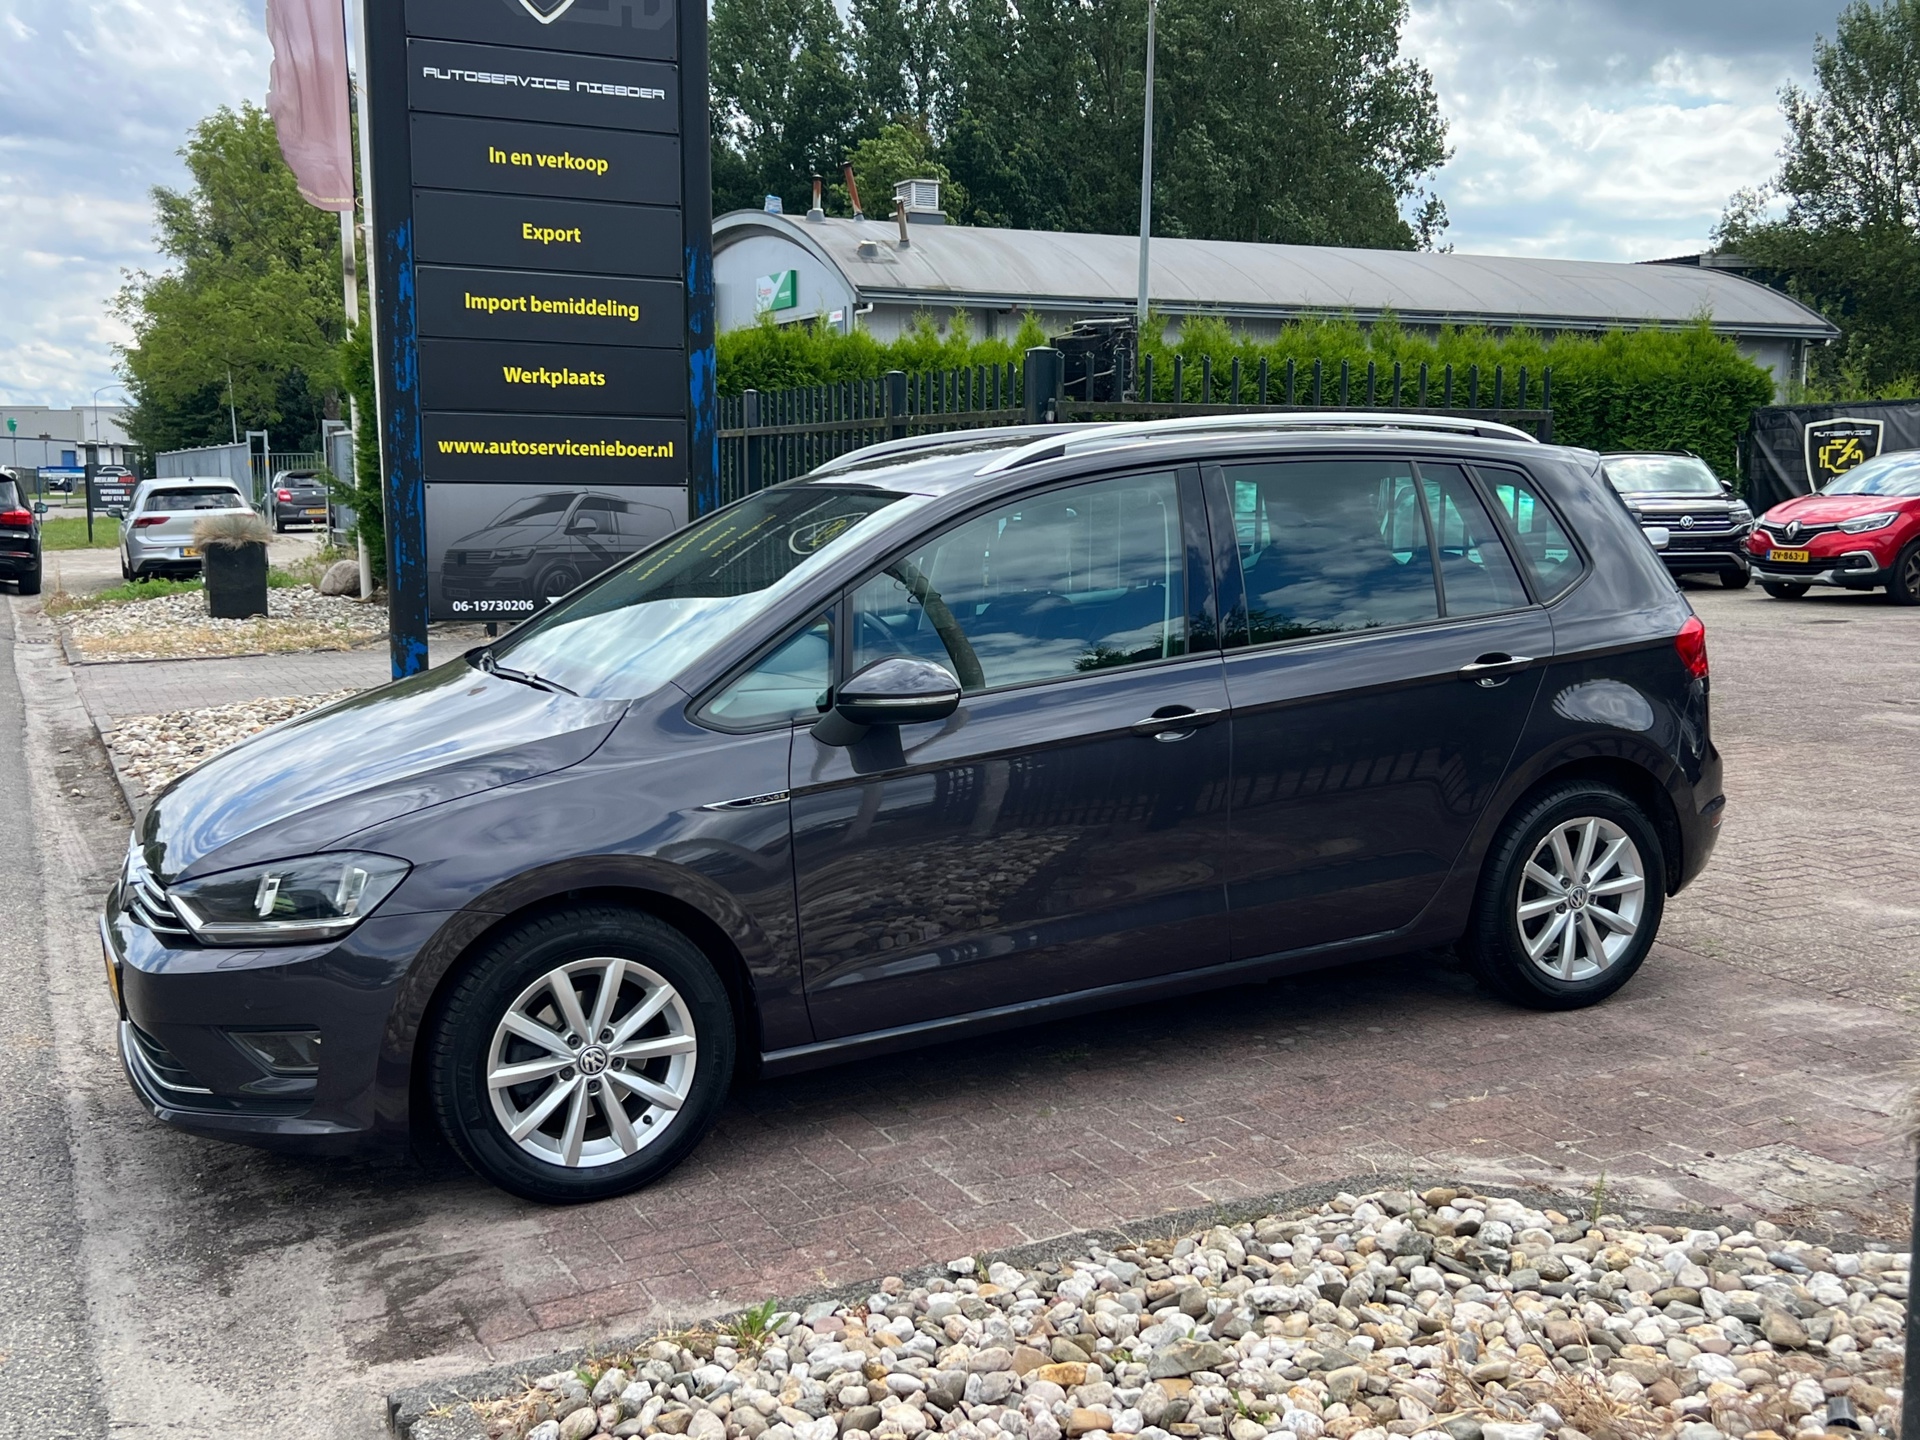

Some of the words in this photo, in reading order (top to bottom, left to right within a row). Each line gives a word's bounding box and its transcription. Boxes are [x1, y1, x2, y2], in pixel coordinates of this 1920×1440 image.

[423, 66, 571, 91] AUTOSERVICE
[576, 81, 665, 100] NIEBOER
[489, 146, 507, 164] In
[510, 152, 533, 166] en
[536, 152, 609, 175] verkoop
[523, 223, 581, 244] Export
[465, 293, 527, 314] Import
[530, 295, 639, 322] bemiddeling
[503, 367, 606, 388] Werkplaats
[1813, 429, 1872, 438] AUTOSERVICE
[438, 440, 674, 458] www.autoservicenieboer.nl
[1771, 551, 1805, 561] ZV-863-J
[452, 600, 534, 612] 06-19730206
[750, 793, 786, 804] LOUNGE
